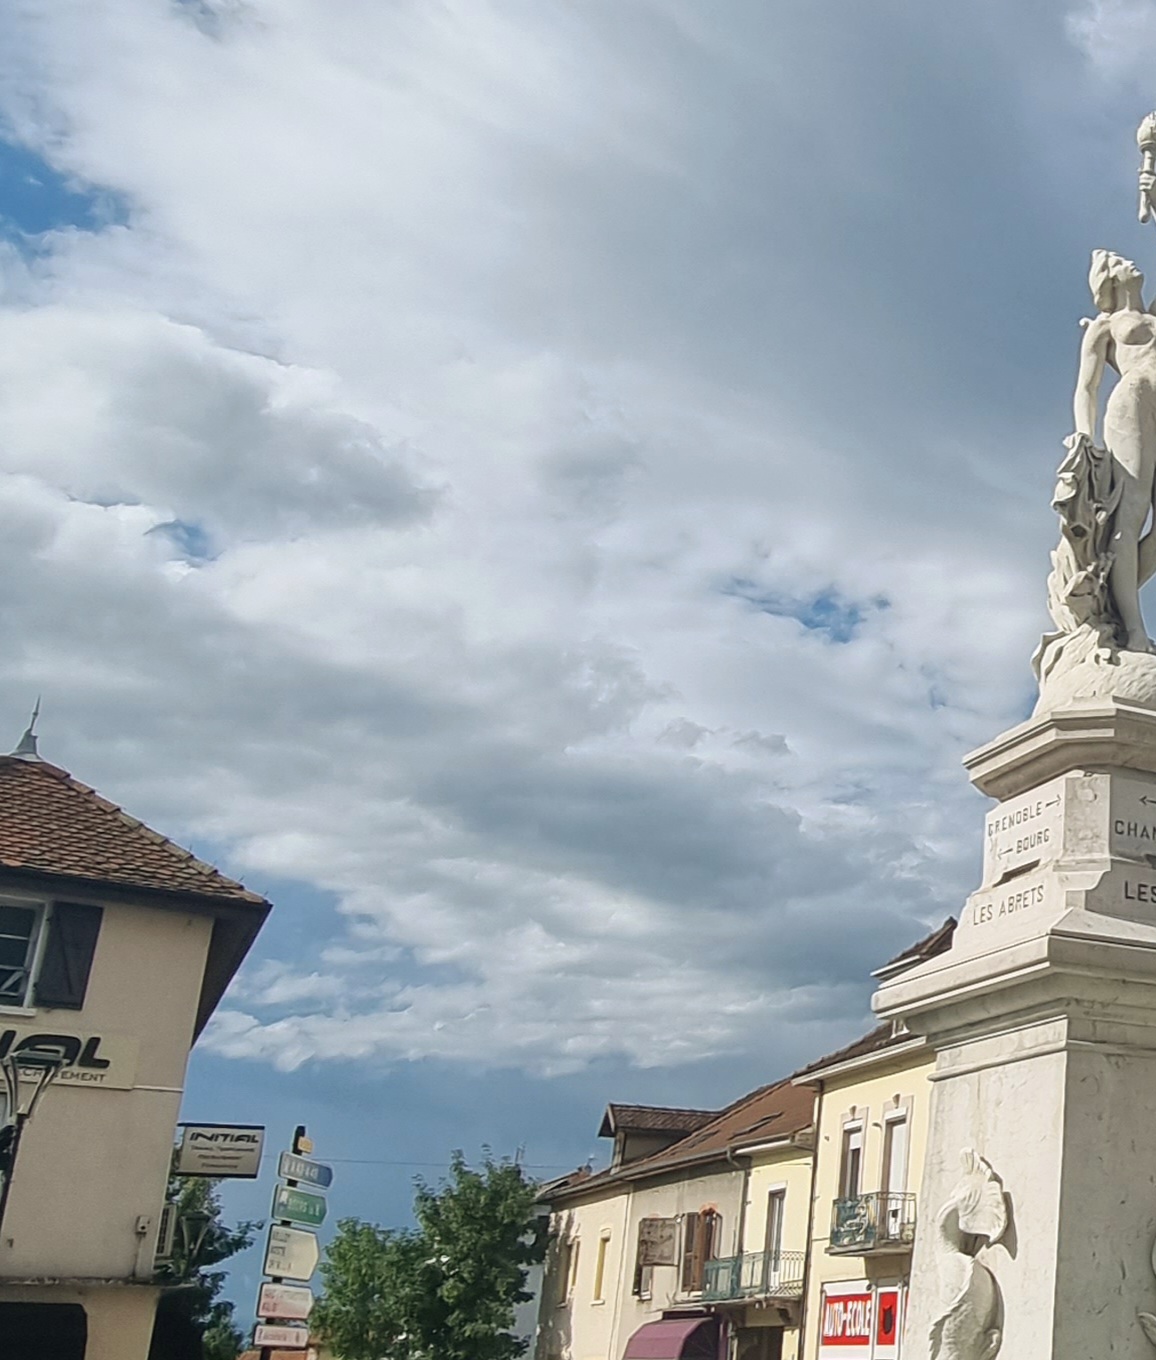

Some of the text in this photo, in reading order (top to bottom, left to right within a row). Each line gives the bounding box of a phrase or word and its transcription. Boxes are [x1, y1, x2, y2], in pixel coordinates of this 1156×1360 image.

[988, 801, 1042, 837] GRENOBLE
[1016, 828, 1050, 854] BOURG
[973, 884, 1044, 926] LES ABRETS
[190, 1132, 259, 1143] INITIAL
[824, 1300, 871, 1337] AUTO-ECOLE
